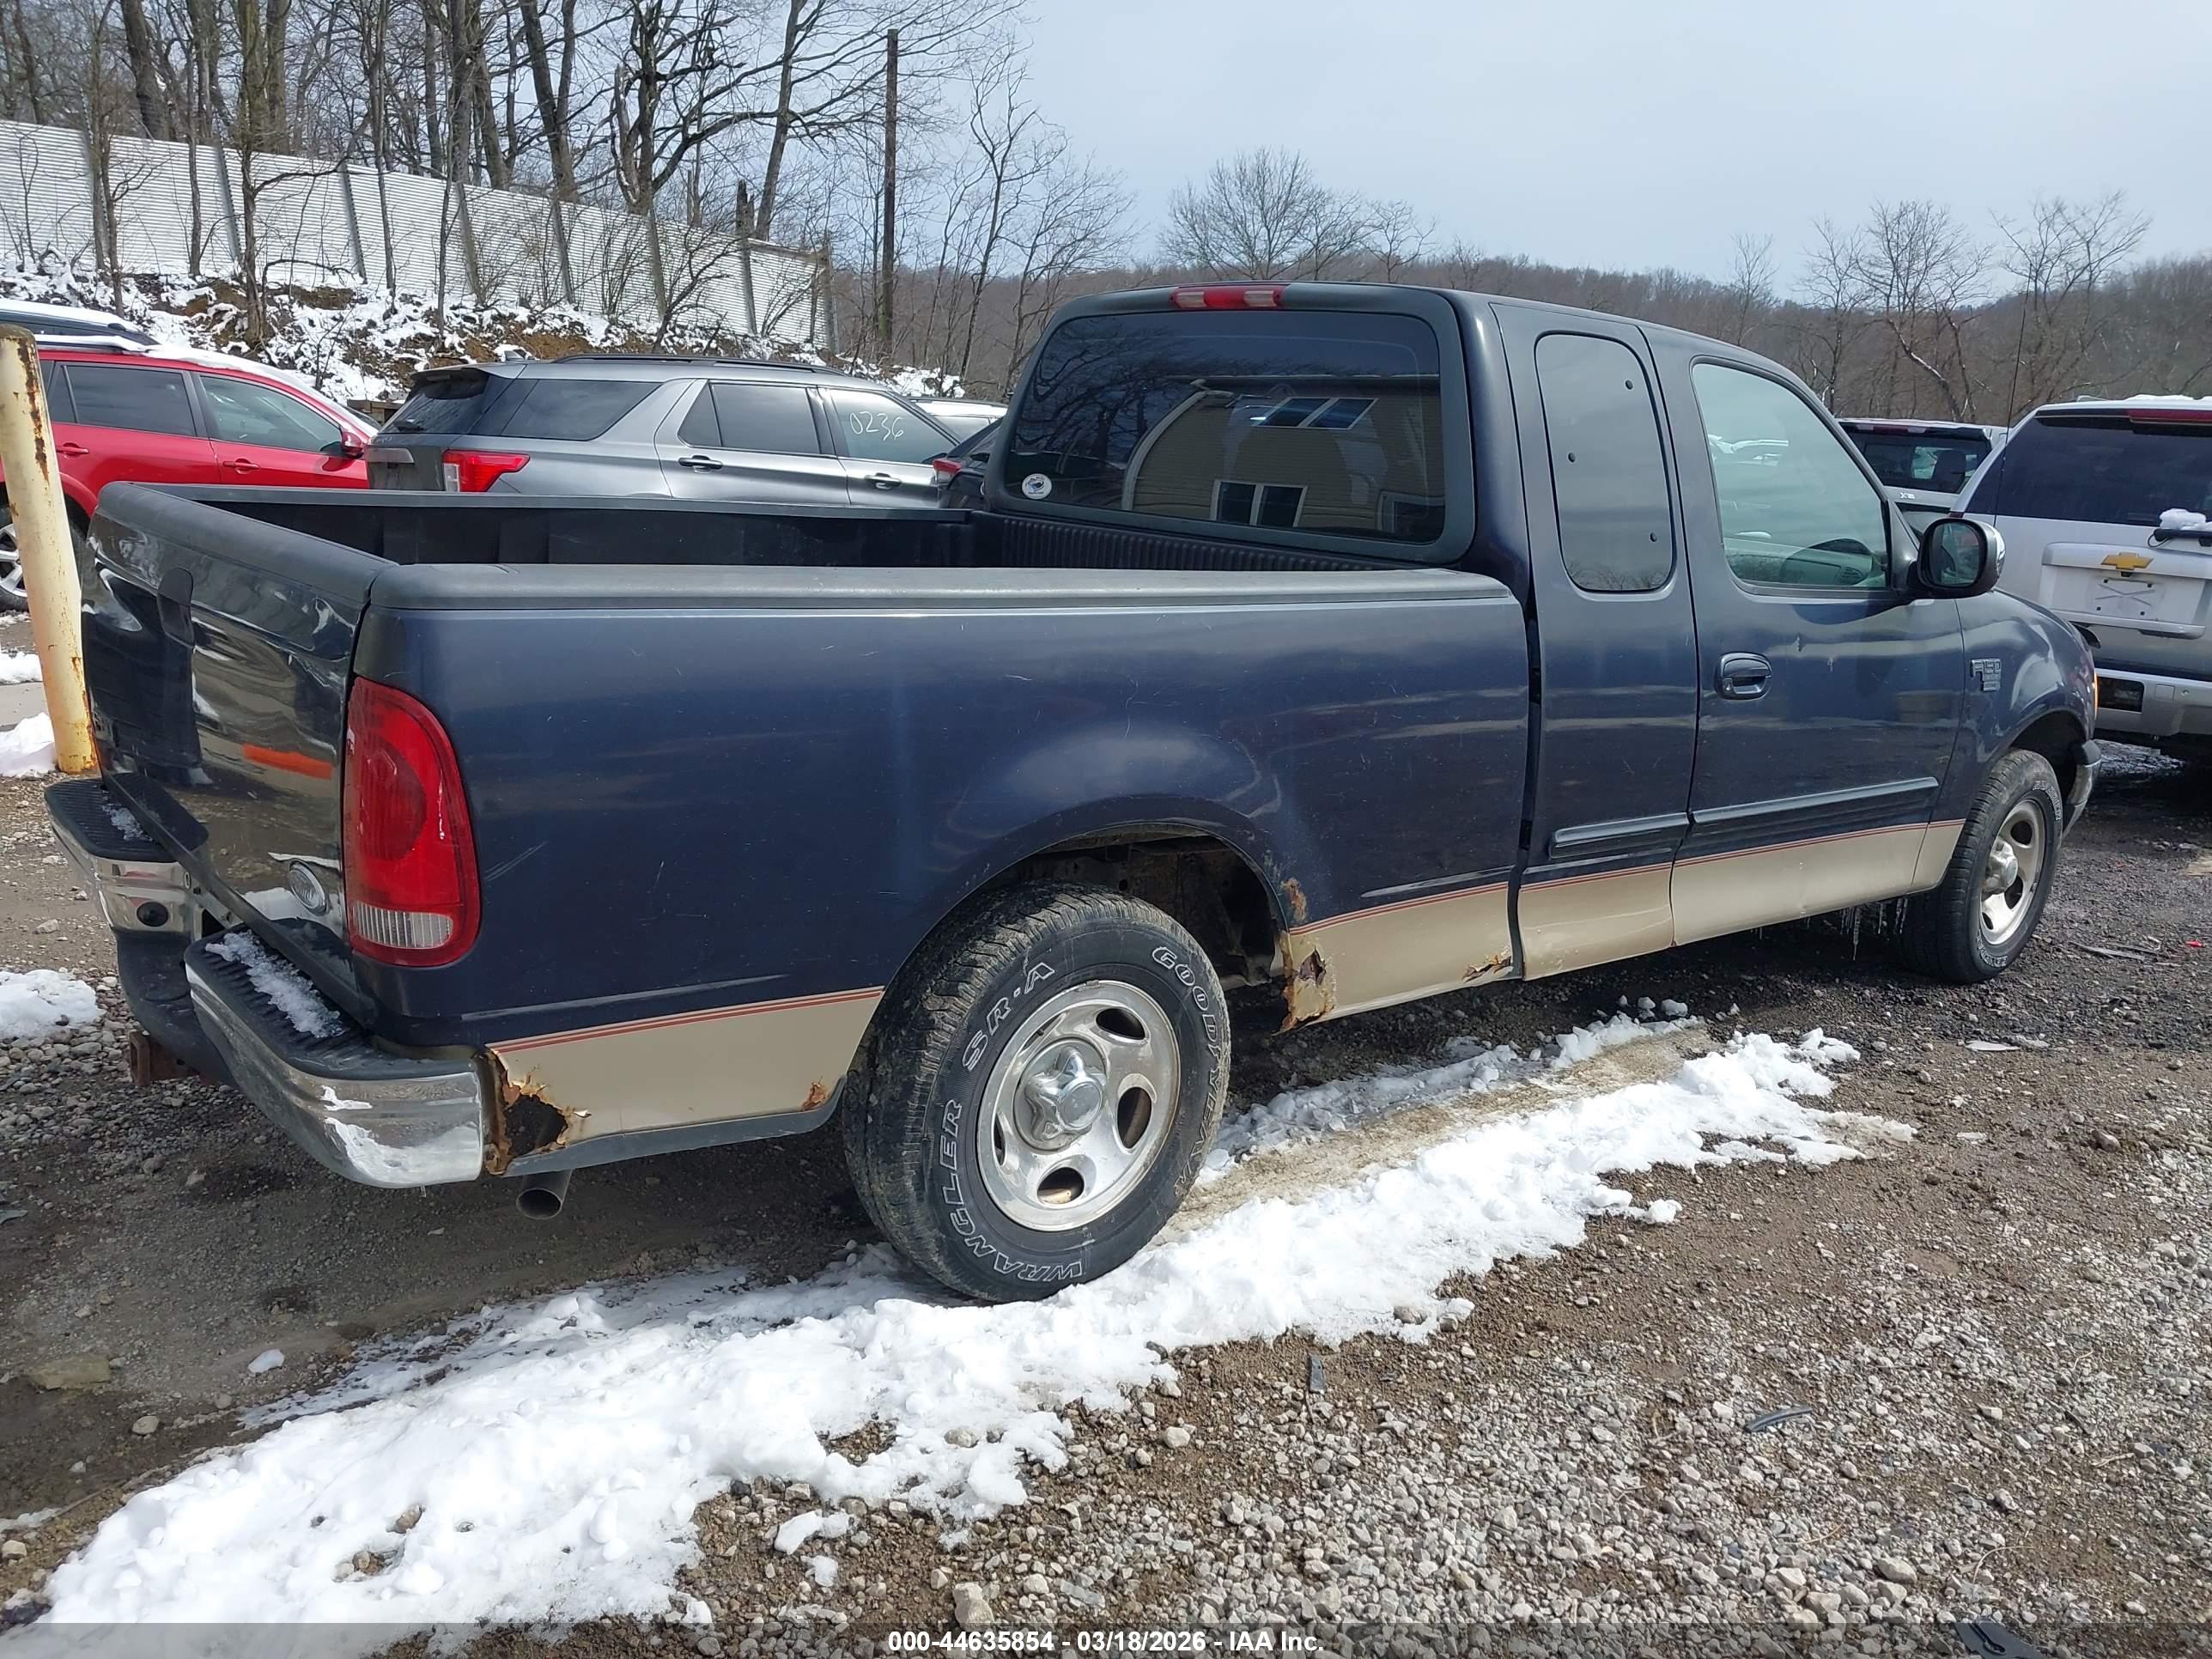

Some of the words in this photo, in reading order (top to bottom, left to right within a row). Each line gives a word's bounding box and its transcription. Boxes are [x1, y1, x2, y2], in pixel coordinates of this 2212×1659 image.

[849, 410, 904, 441] 0236
[1152, 945, 1223, 1193] GOODYEAR
[939, 1098, 1083, 1283] WRANGLER
